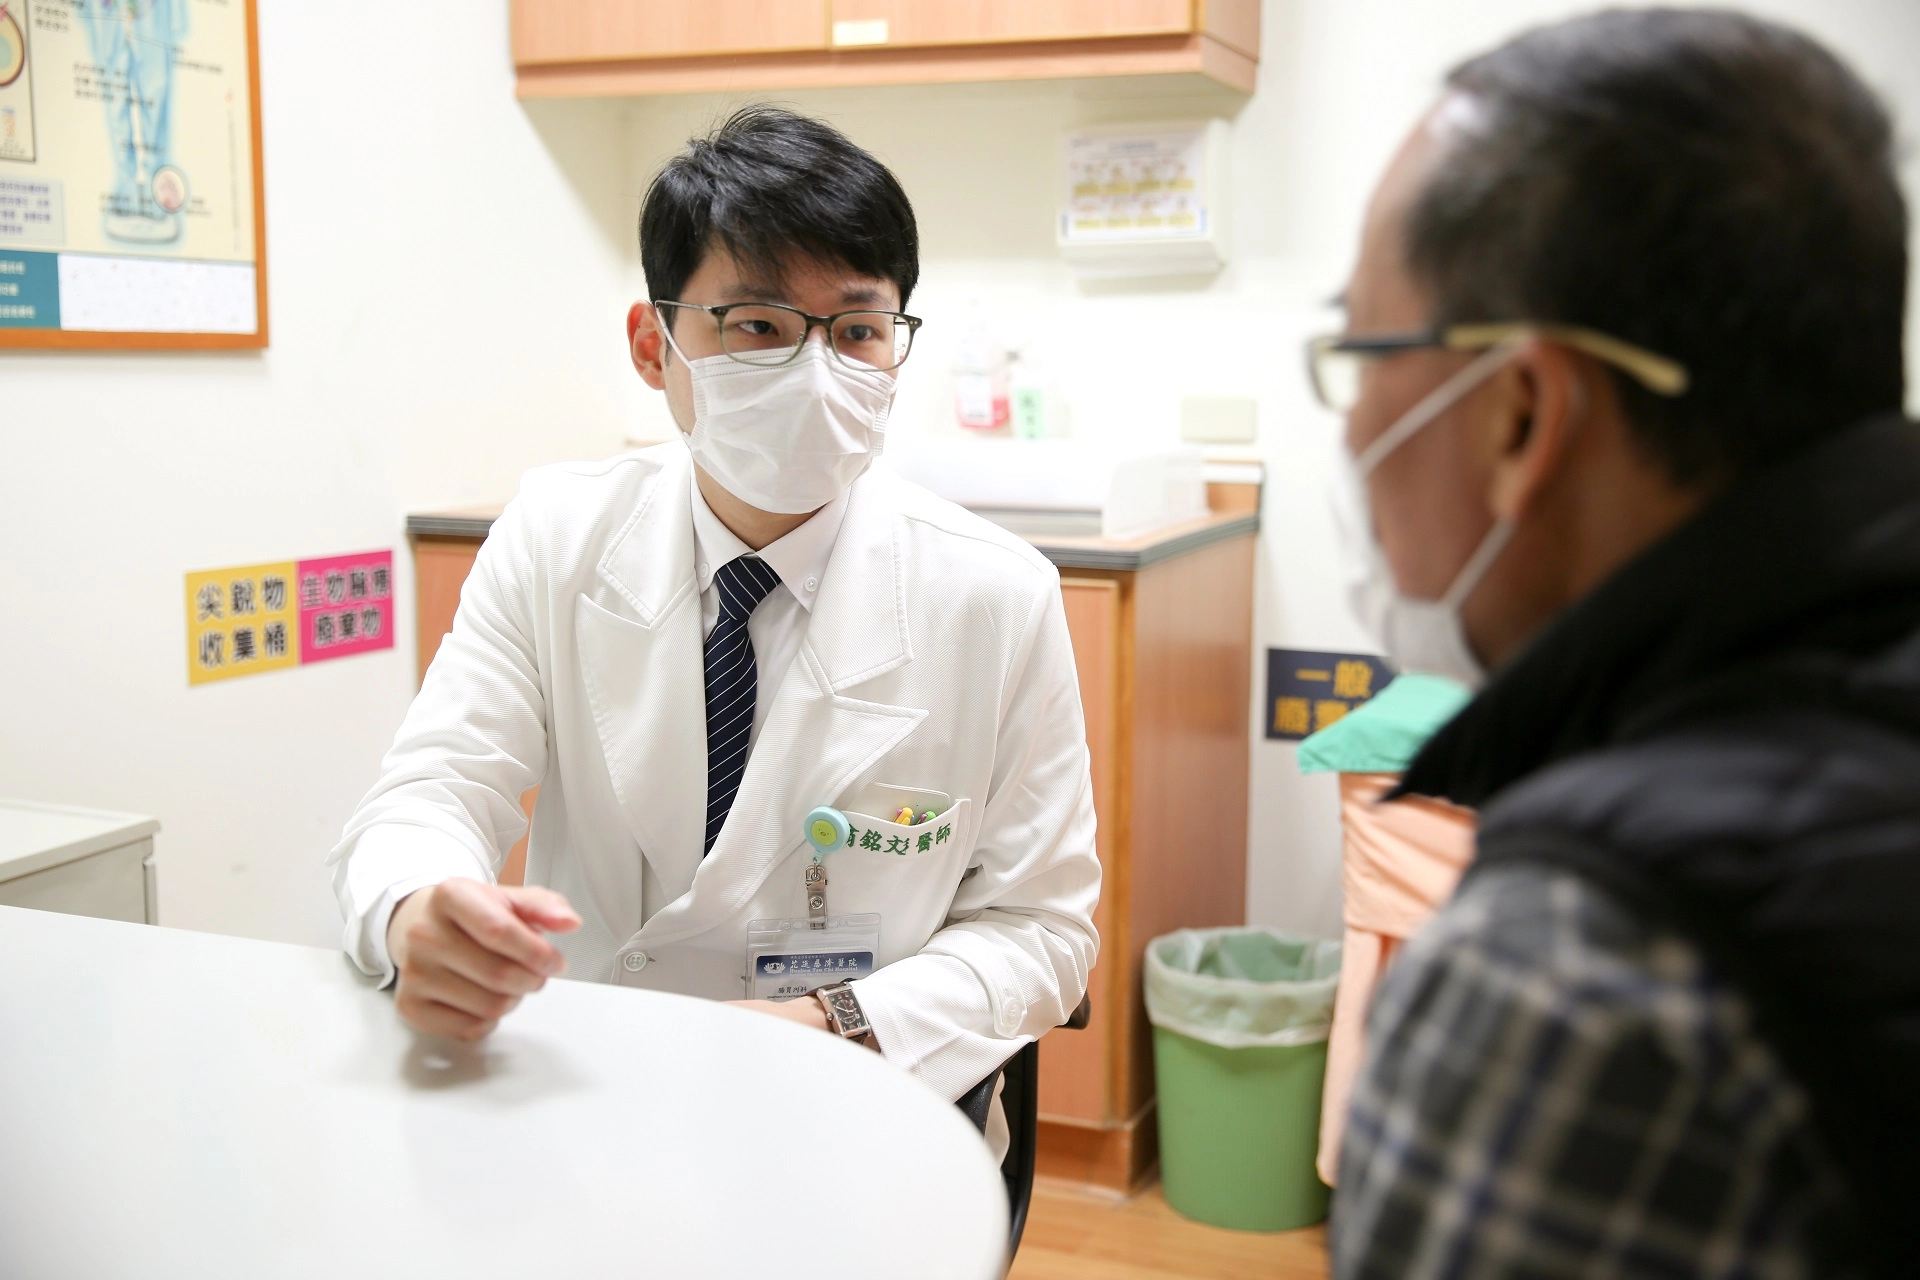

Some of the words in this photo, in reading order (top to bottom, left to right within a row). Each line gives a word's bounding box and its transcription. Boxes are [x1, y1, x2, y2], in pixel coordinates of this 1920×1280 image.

[196, 575, 286, 622] 尖銳物
[198, 622, 286, 669] 收集桶
